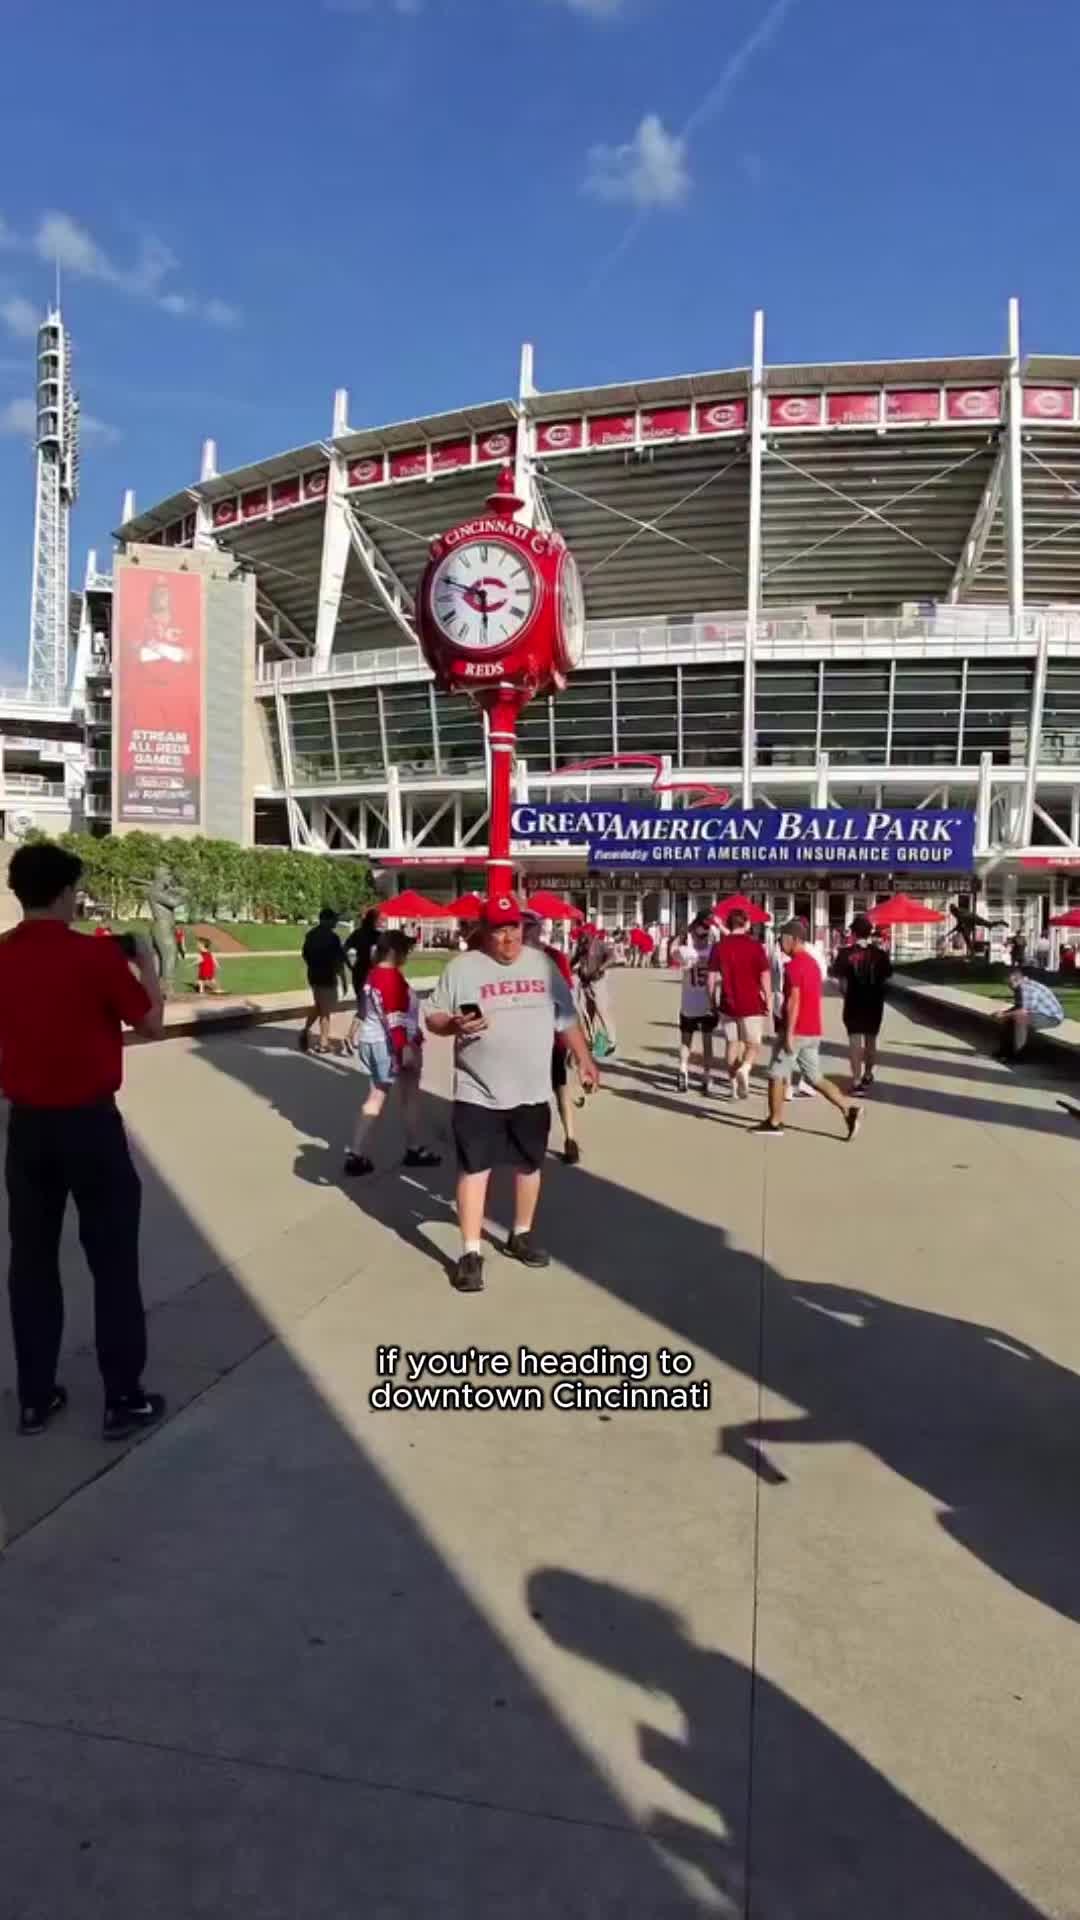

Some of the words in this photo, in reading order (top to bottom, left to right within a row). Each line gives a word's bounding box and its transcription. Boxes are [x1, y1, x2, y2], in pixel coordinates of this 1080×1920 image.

[444, 521, 528, 545] CINCINNATI
[464, 661, 504, 677] REDS
[132, 730, 188, 743] STREAM
[128, 741, 152, 752] ALL
[155, 743, 191, 755] REDS
[133, 753, 183, 766] GAMES
[511, 807, 612, 833] GREAT
[600, 813, 763, 841] AMERICAN
[776, 813, 861, 841] BALL
[864, 812, 953, 842] PARK
[652, 846, 700, 860] GREAT
[707, 846, 789, 860] AMERICAN
[797, 846, 889, 861] INSURANCE
[897, 846, 953, 862] GROUP
[480, 979, 545, 998] REDS
